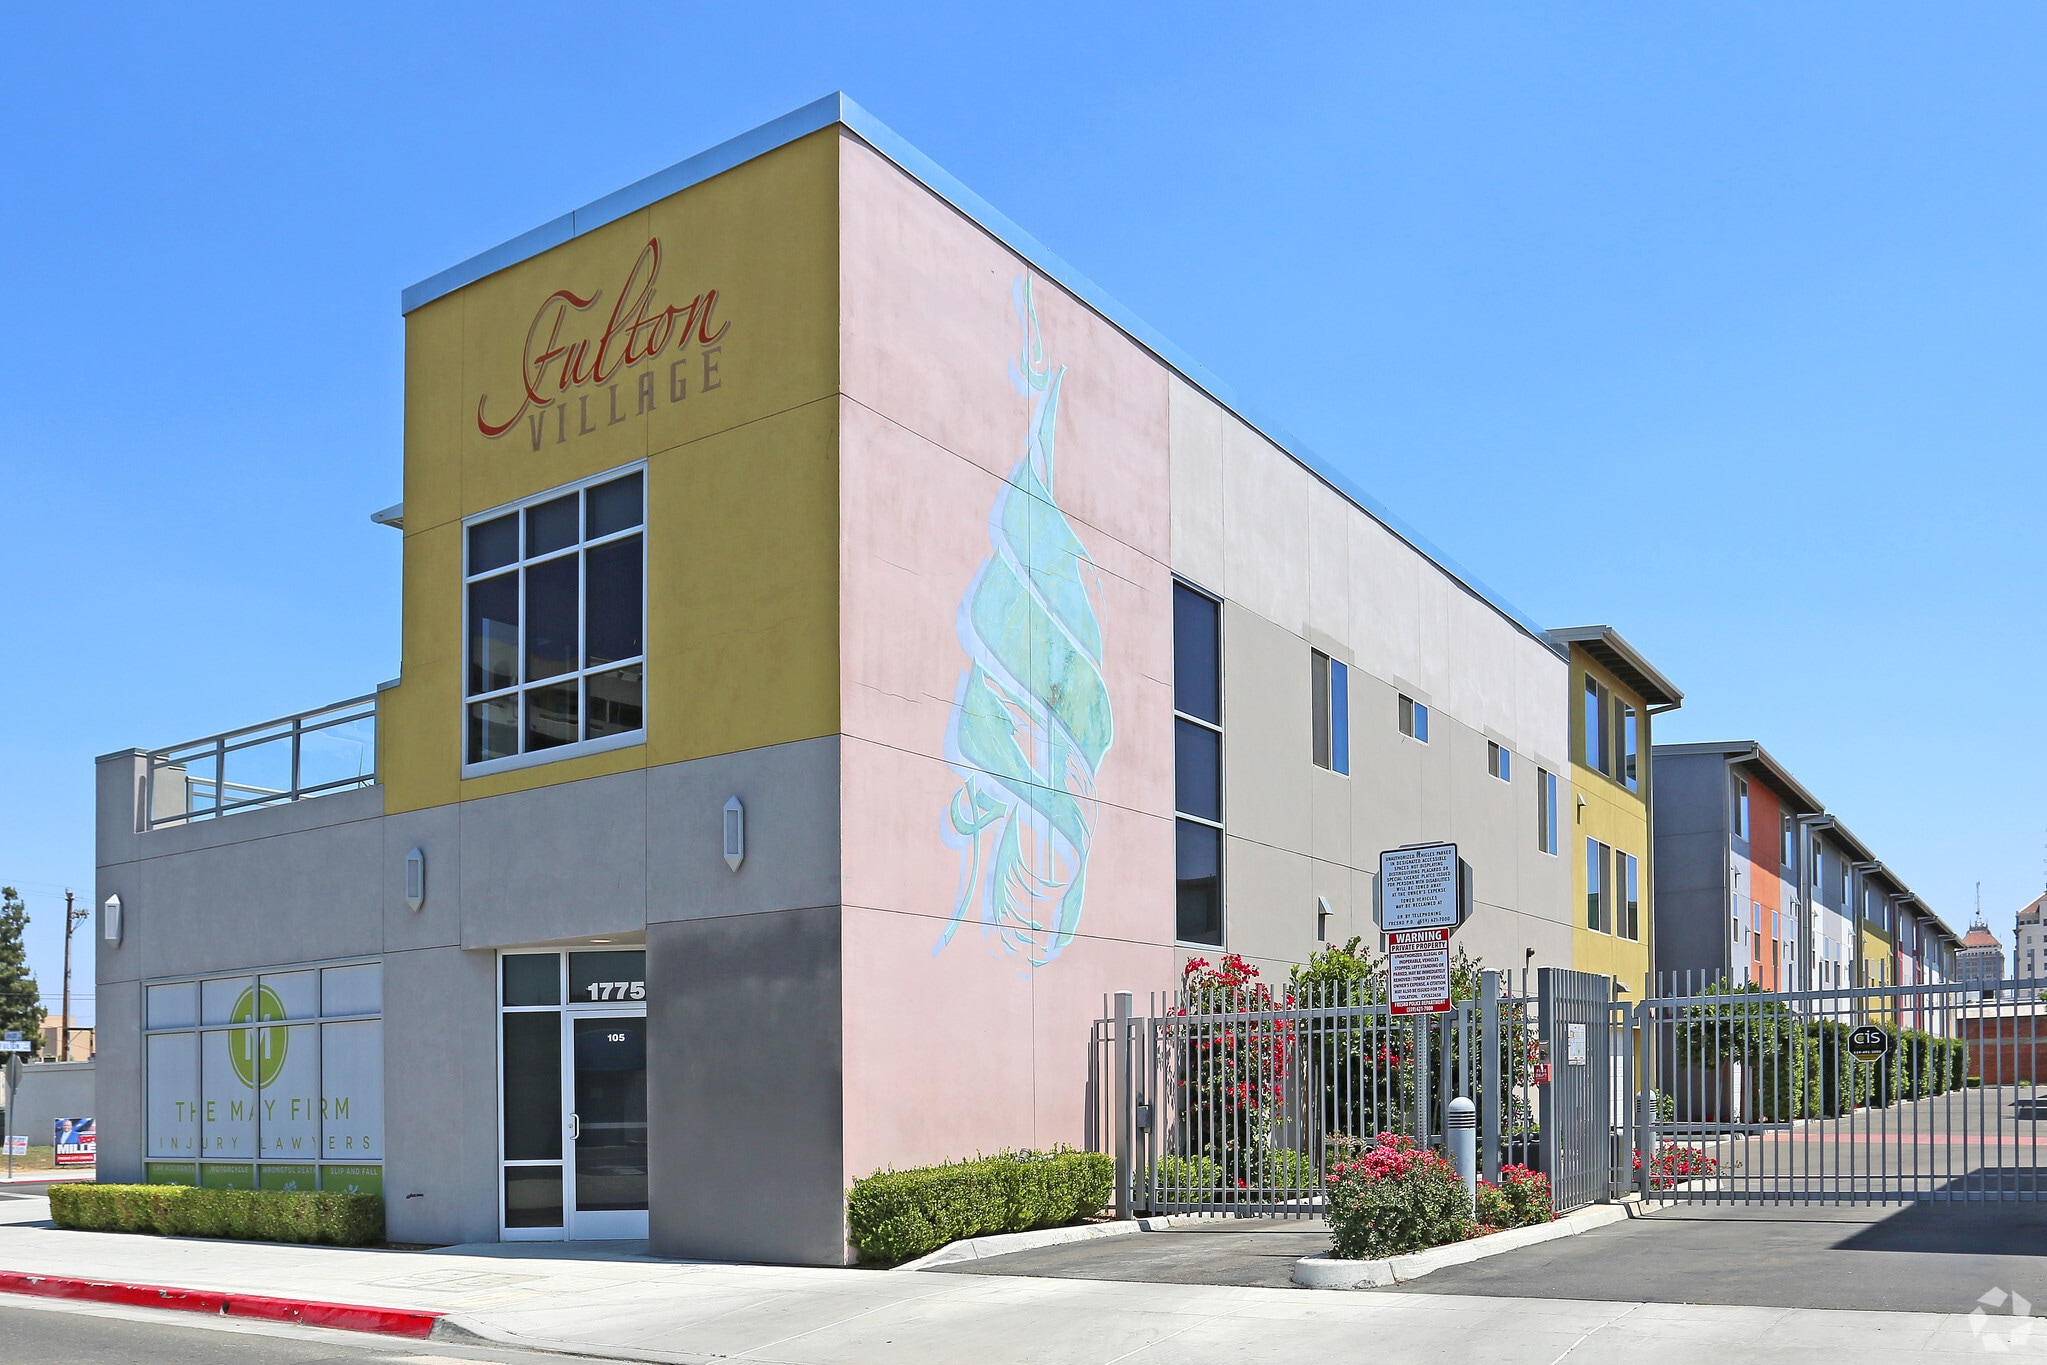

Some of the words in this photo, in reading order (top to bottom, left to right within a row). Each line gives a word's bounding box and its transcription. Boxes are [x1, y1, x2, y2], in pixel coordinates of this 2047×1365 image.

[478, 236, 731, 440] Fulton
[528, 346, 722, 452] VILLAGE
[1396, 930, 1442, 944] WARNING
[1416, 941, 1446, 950] PROPERTY
[586, 982, 646, 1000] 1775
[245, 1014, 270, 1060] M
[608, 1034, 626, 1042] 105
[292, 1097, 348, 1120] FIRM
[160, 1136, 238, 1150] INJURY
